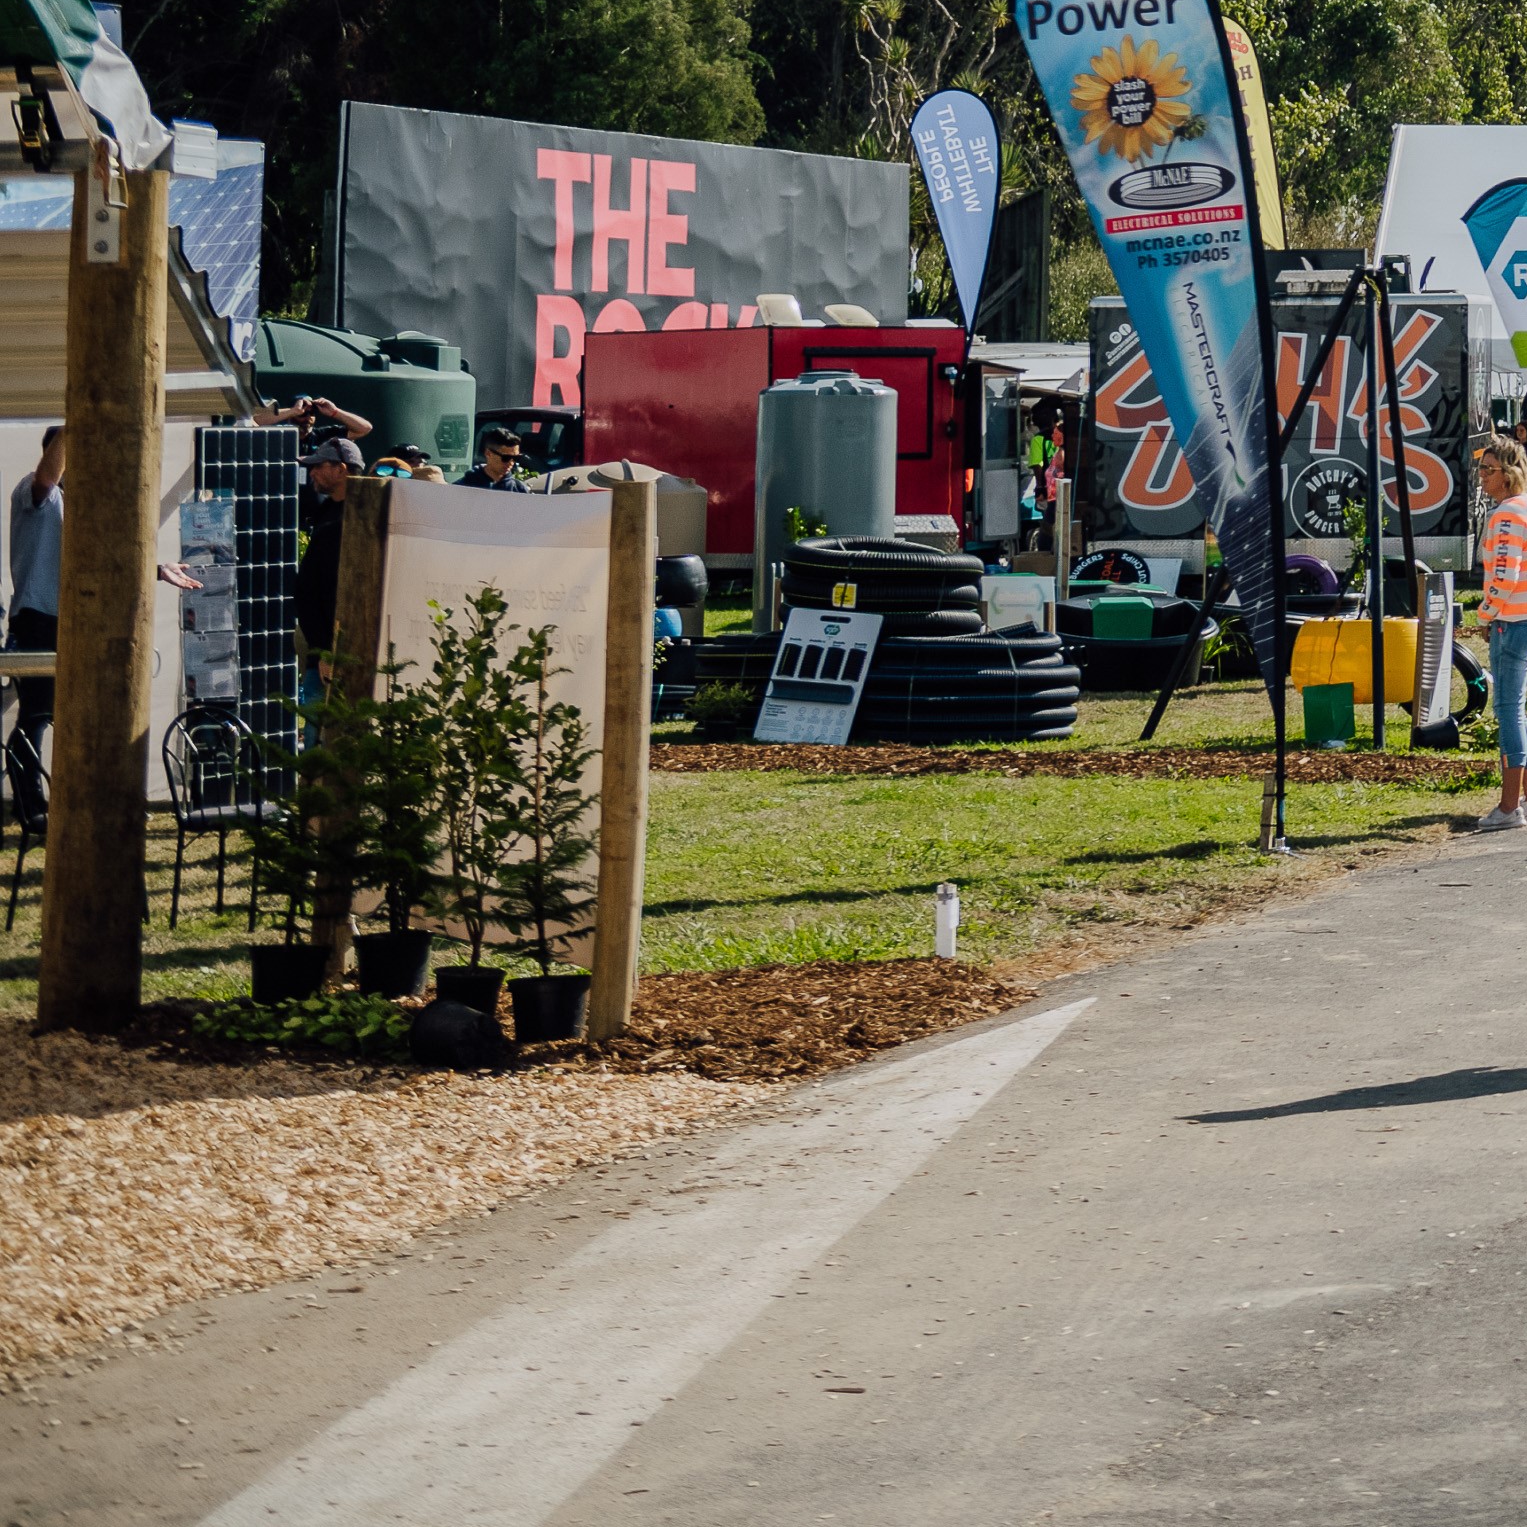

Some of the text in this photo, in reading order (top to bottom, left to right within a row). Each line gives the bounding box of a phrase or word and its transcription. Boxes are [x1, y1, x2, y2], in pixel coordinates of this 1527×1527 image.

[1113, 79, 1146, 92] slash
[1111, 102, 1151, 117] power
[1116, 92, 1145, 106] your
[1121, 112, 1143, 125] bill
[536, 148, 697, 297] THE
[1112, 208, 1236, 231] ELECTRICAL SOLUTIONS
[1126, 229, 1241, 253] mcnae.co.nz
[1138, 247, 1230, 269] Ph 3570405
[1182, 281, 1233, 438] MASTERCRAFT
[1305, 469, 1359, 493] DUTCHY'S
[1069, 553, 1104, 580] BURGERS
